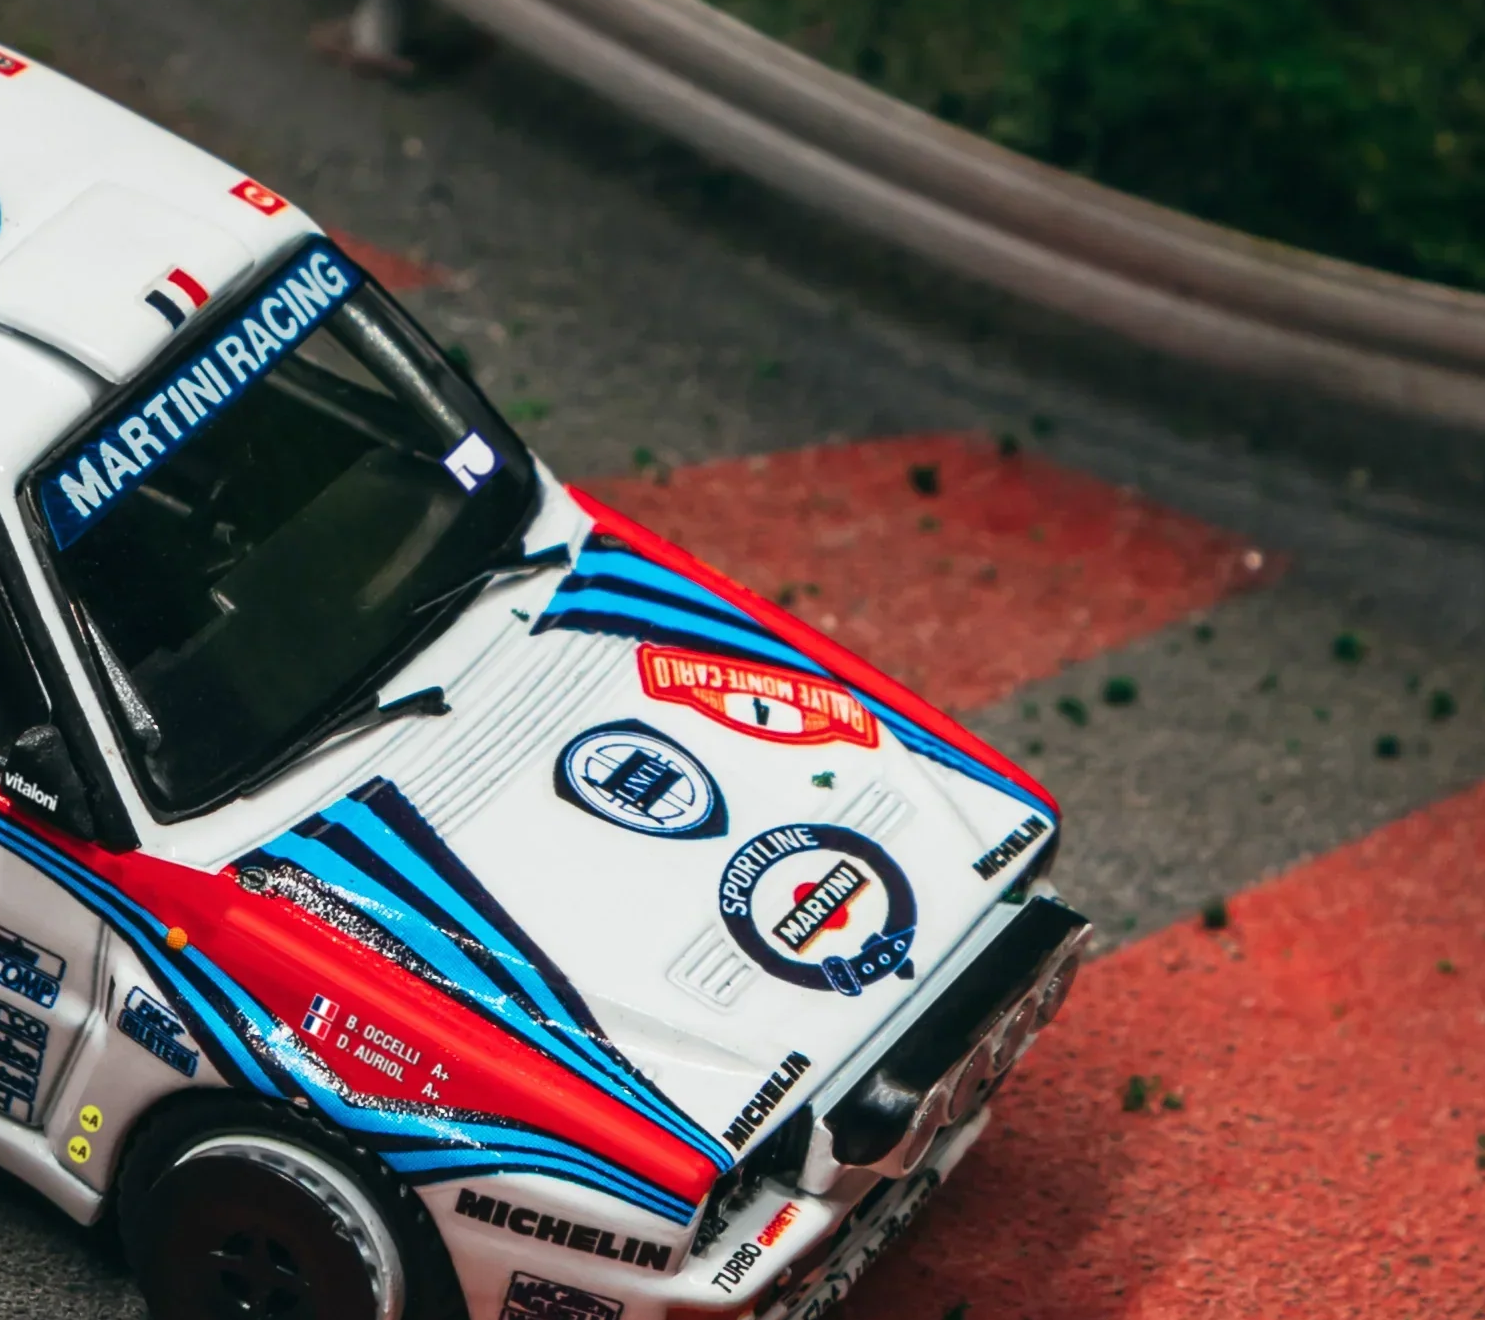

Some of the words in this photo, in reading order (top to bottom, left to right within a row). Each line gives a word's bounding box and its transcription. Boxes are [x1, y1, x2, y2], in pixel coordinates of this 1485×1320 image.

[59, 357, 232, 518] MARTINI
[215, 252, 349, 383] RACING
[752, 696, 771, 727] 4
[798, 683, 866, 734] RALLYE
[4, 772, 60, 812] vitaloni
[722, 827, 820, 917] SPORTLINE
[971, 813, 1049, 882] MICHELIN
[779, 866, 859, 945] MARTINI
[336, 1034, 350, 1053] D.
[353, 1045, 405, 1083] AURIOL
[421, 1082, 440, 1101] A+
[345, 1014, 359, 1033] B.
[363, 1024, 421, 1066] OCCELLI
[430, 1063, 450, 1082] A+
[721, 1049, 812, 1152] MICHELIN
[454, 1187, 673, 1272] MICHELIN
[710, 1241, 763, 1294] TURBO
